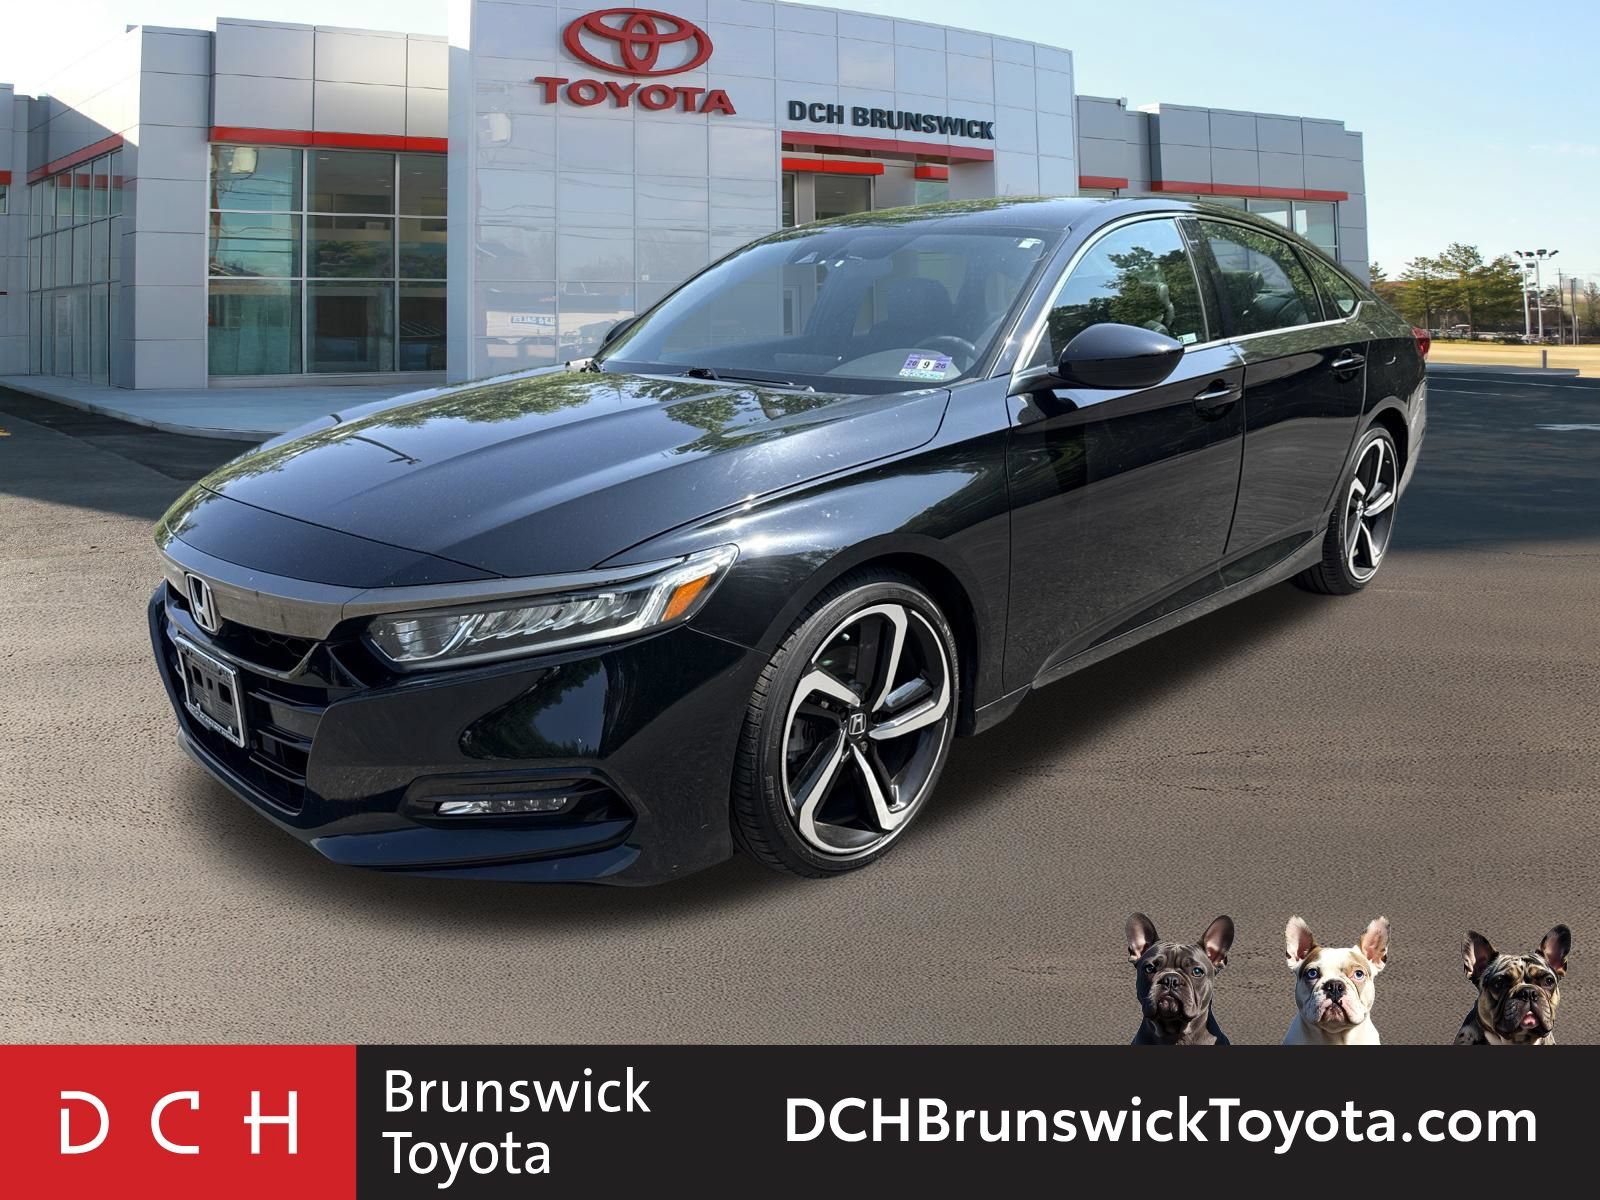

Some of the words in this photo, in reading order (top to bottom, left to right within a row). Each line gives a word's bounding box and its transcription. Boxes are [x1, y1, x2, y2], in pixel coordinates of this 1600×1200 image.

[534, 76, 736, 115] TOYOTA
[788, 99, 845, 125] DCH
[851, 106, 995, 141] BRUNSWICK
[922, 360, 931, 369] 9
